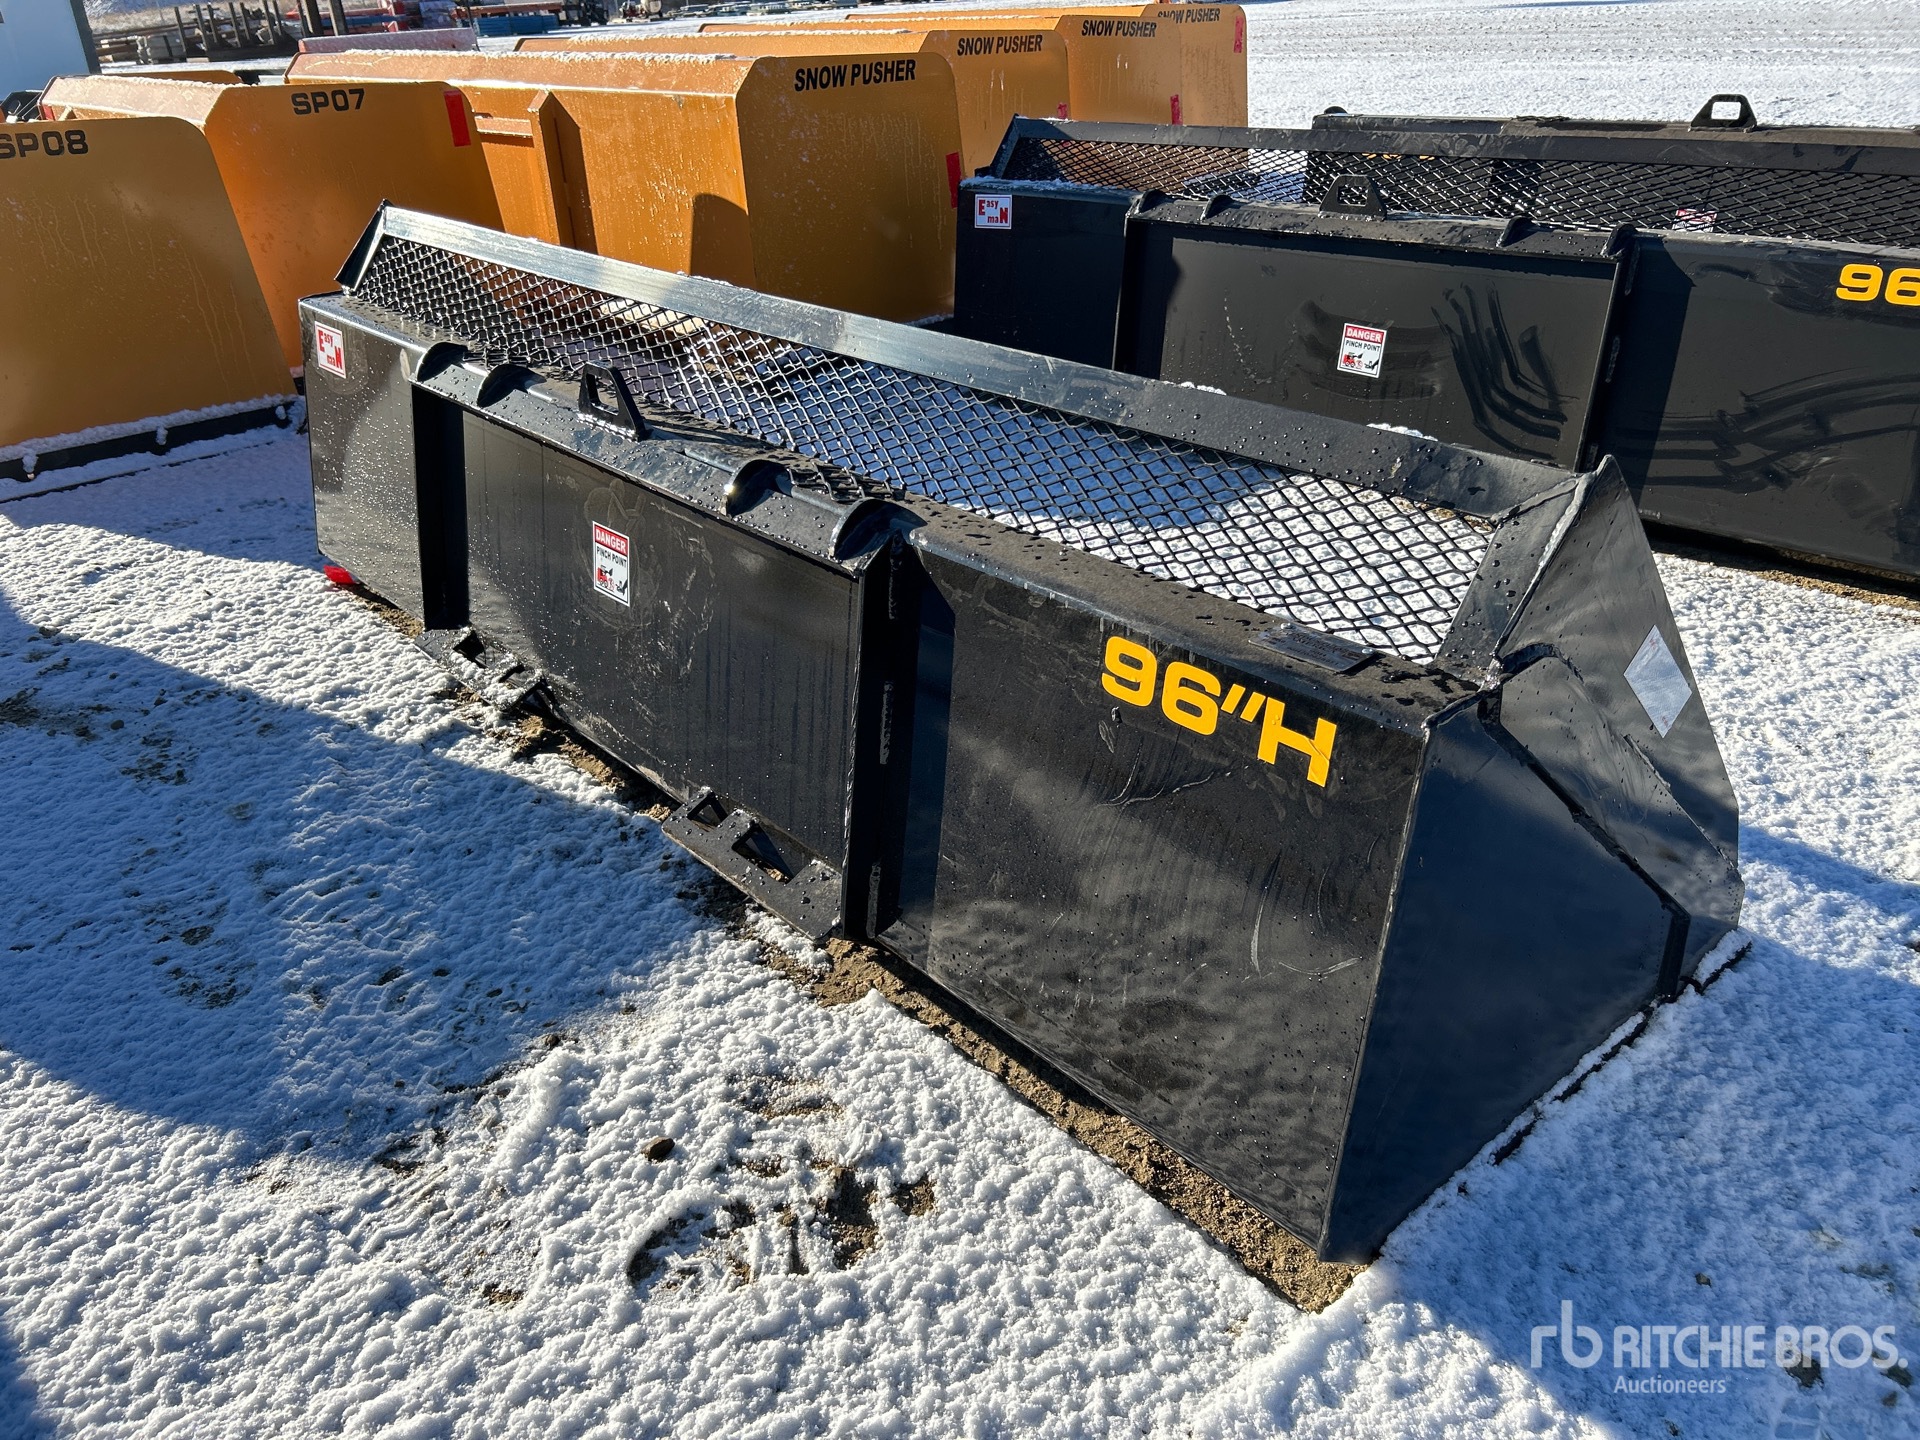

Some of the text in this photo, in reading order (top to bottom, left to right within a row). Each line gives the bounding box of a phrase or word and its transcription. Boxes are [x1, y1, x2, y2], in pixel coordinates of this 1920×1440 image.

[1185, 8, 1220, 23] PUSHER
[1081, 20, 1157, 37] SNOW PUSHER
[957, 34, 1043, 56] SNOW PUSHER
[794, 59, 916, 92] SNOW PUSHER
[291, 88, 365, 116] SP07
[0, 129, 89, 159] SP08
[1345, 340, 1380, 352] PINCH POINT
[1347, 328, 1381, 342] DANGER
[596, 529, 626, 553] DANGER
[597, 546, 626, 568] PINCH POINT
